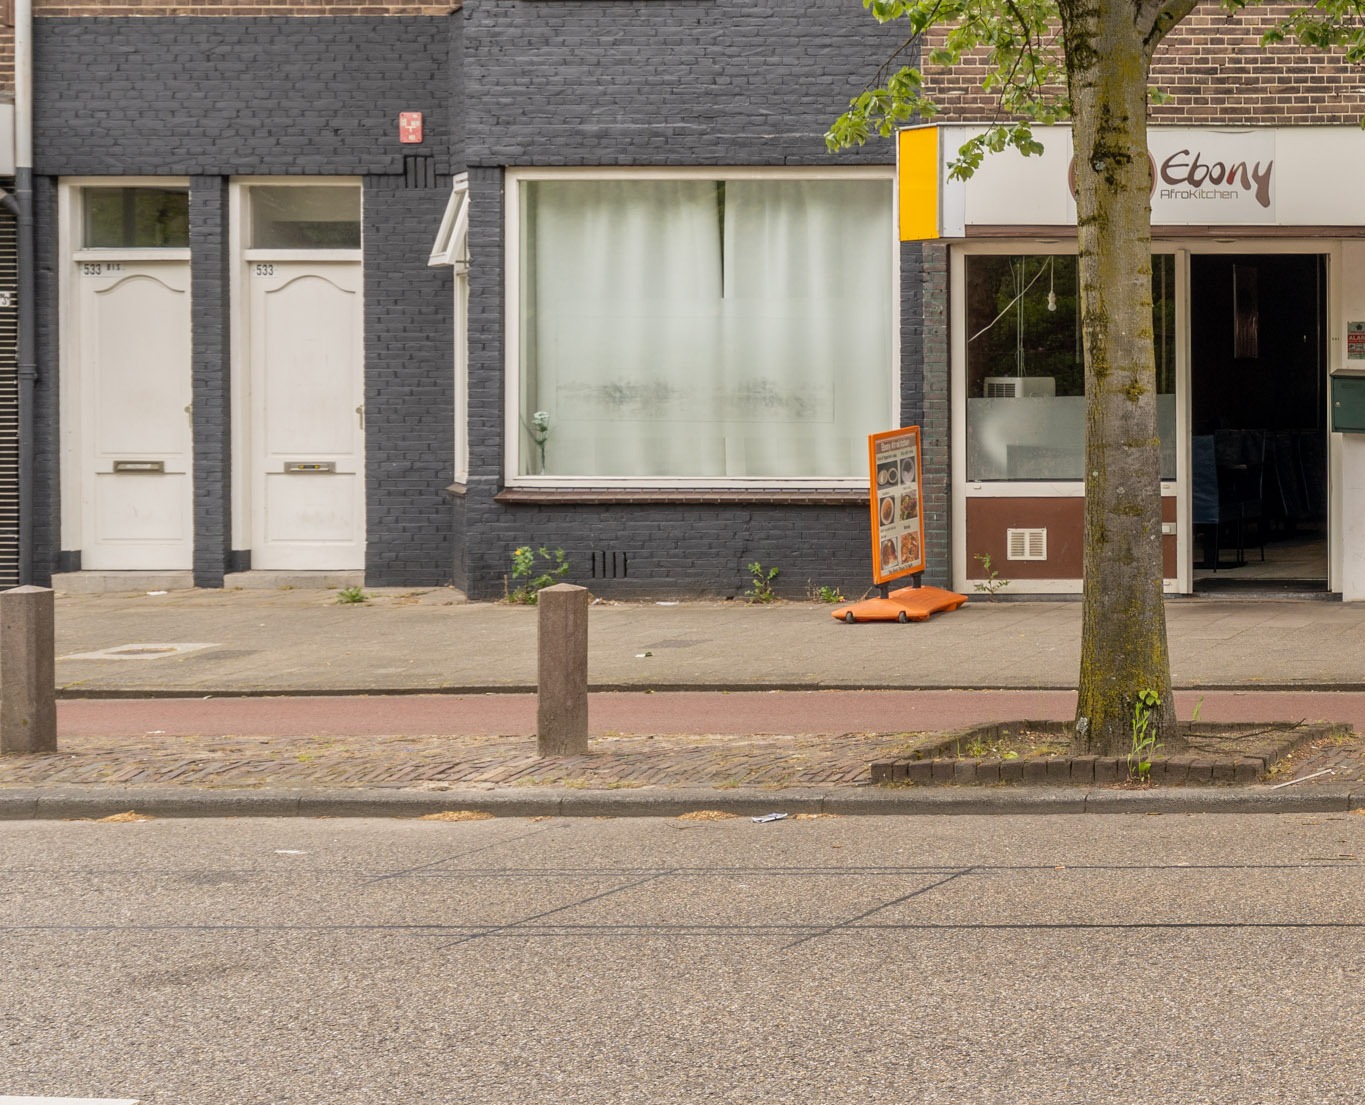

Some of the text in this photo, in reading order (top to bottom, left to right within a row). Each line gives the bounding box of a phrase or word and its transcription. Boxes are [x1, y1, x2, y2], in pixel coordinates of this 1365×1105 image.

[1160, 149, 1274, 208] Ebony
[1160, 189, 1239, 199] AfroKitchen
[83, 263, 102, 276] 533
[256, 264, 274, 276] 533
